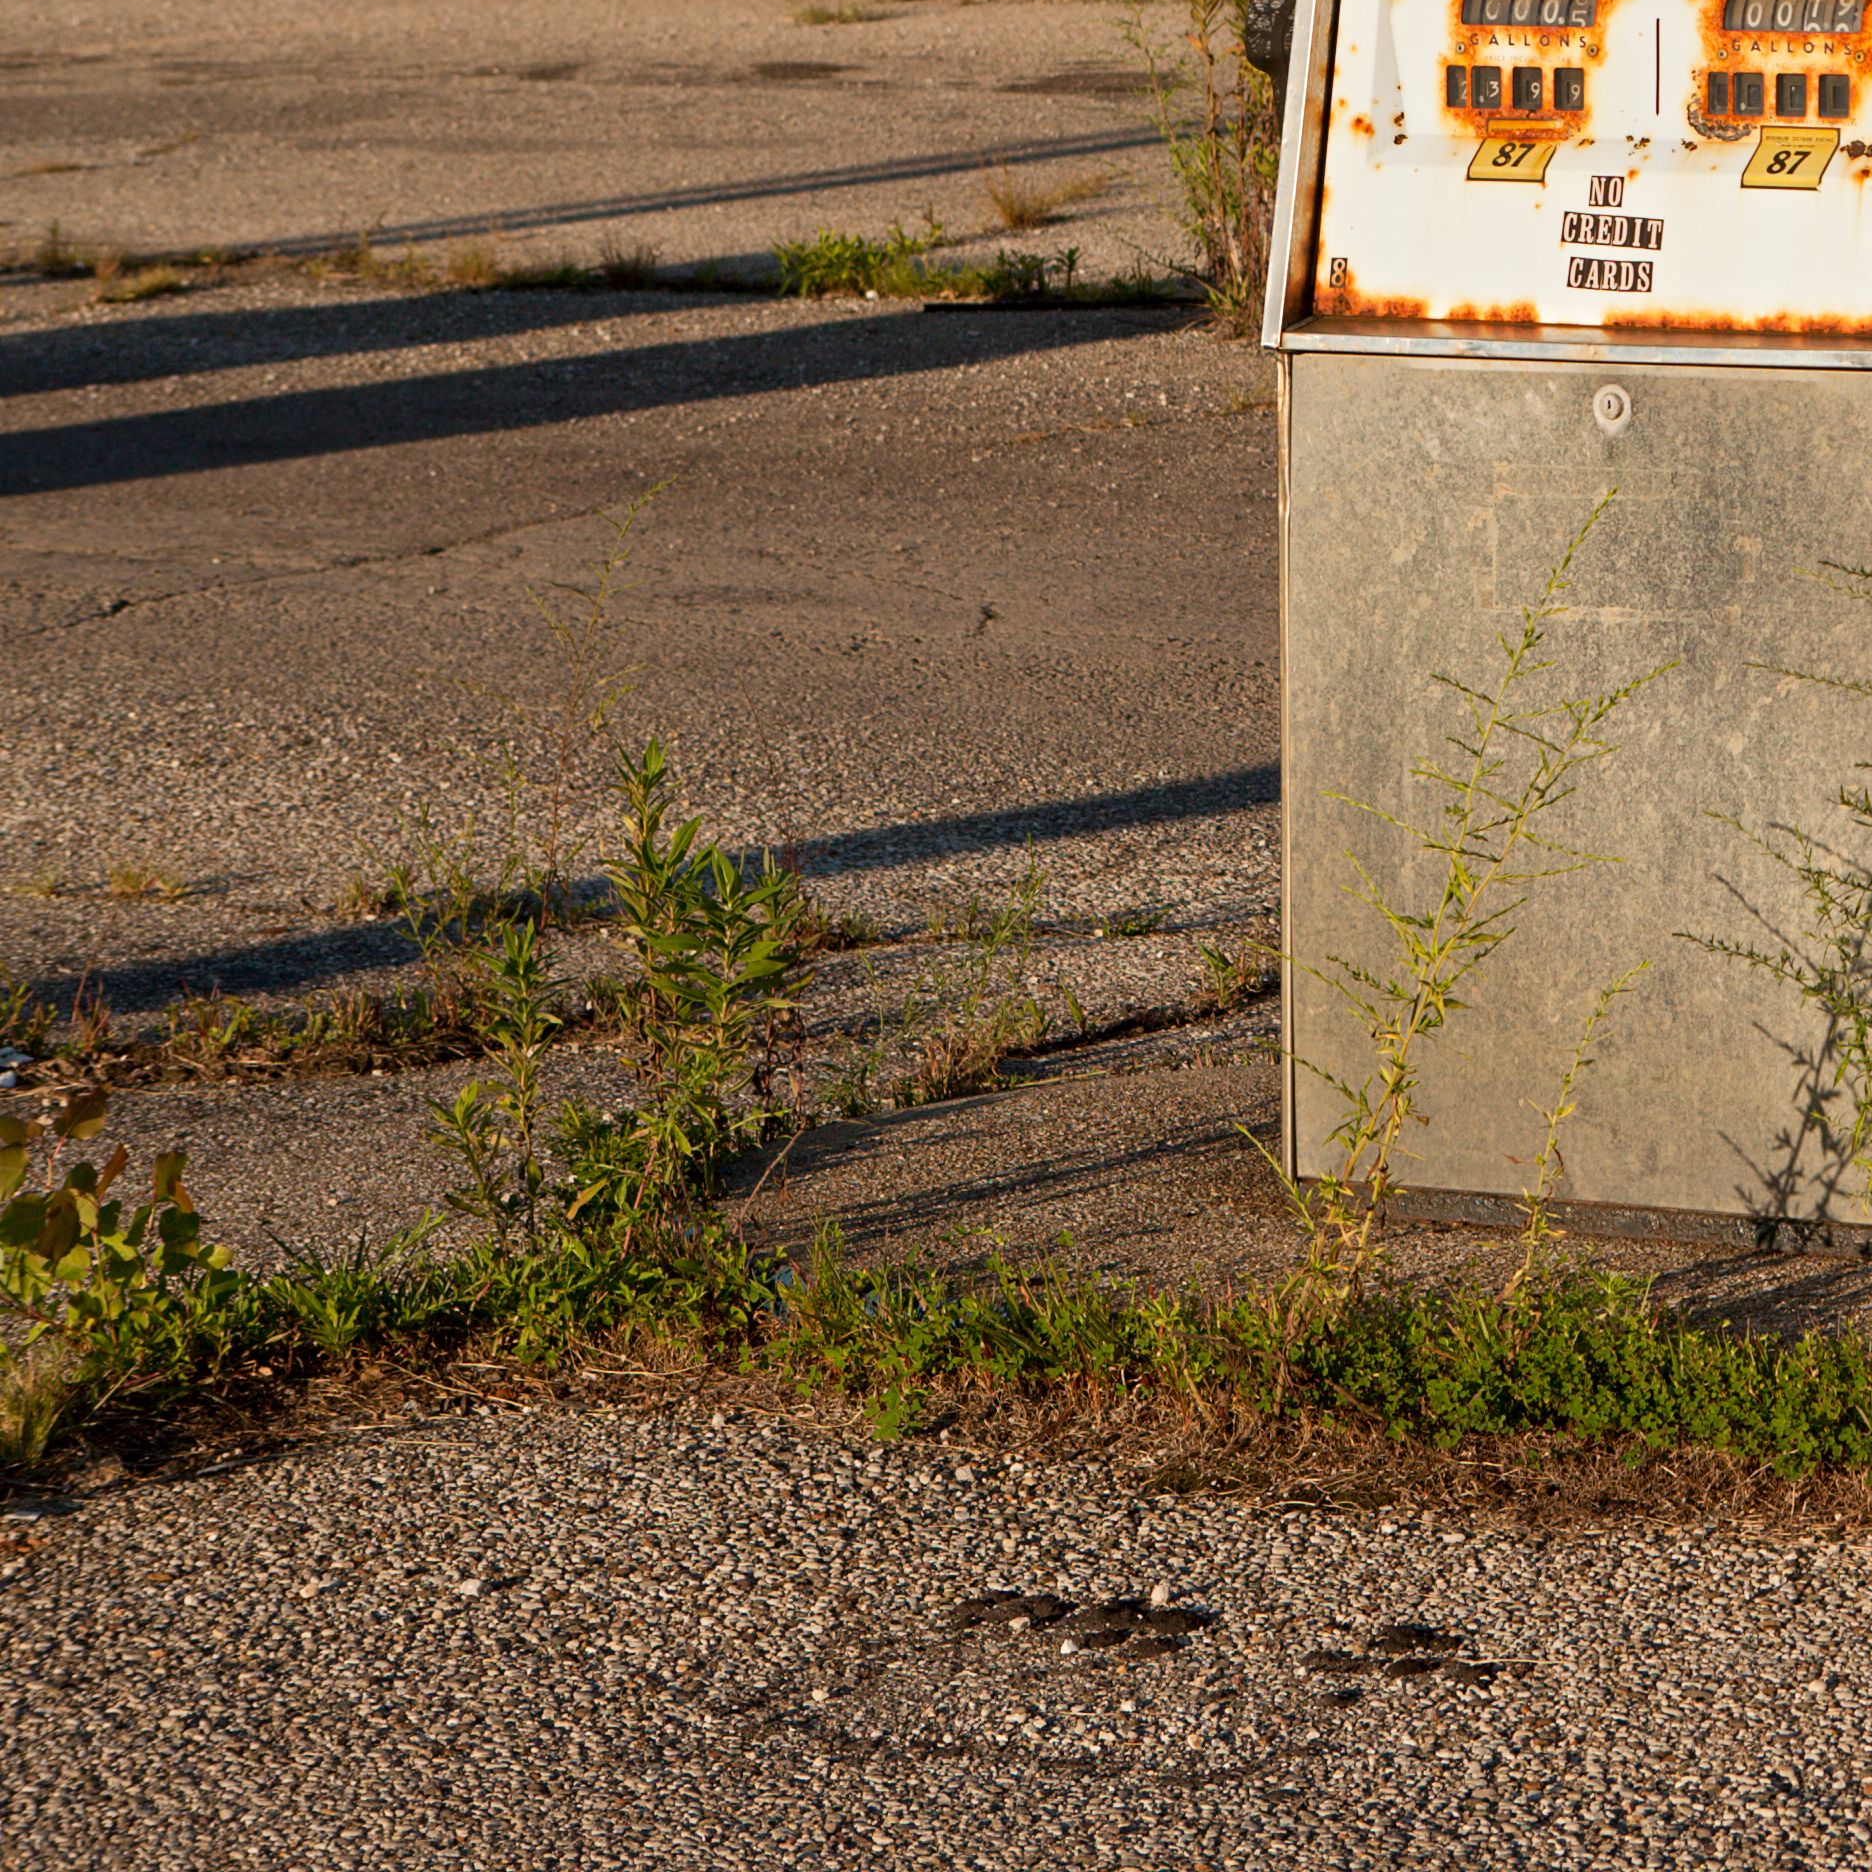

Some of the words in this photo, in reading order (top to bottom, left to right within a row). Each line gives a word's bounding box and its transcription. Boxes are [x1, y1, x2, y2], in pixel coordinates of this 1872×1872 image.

[1469, 34, 1587, 48] GALLONS
[1731, 40, 1853, 55] GALLONS
[1492, 143, 1536, 167] 87
[1766, 150, 1812, 175] 87
[1590, 177, 1623, 206] NO
[1563, 213, 1663, 249] CREDIT
[1331, 260, 1346, 287] 8
[1569, 259, 1653, 291] CARDS
